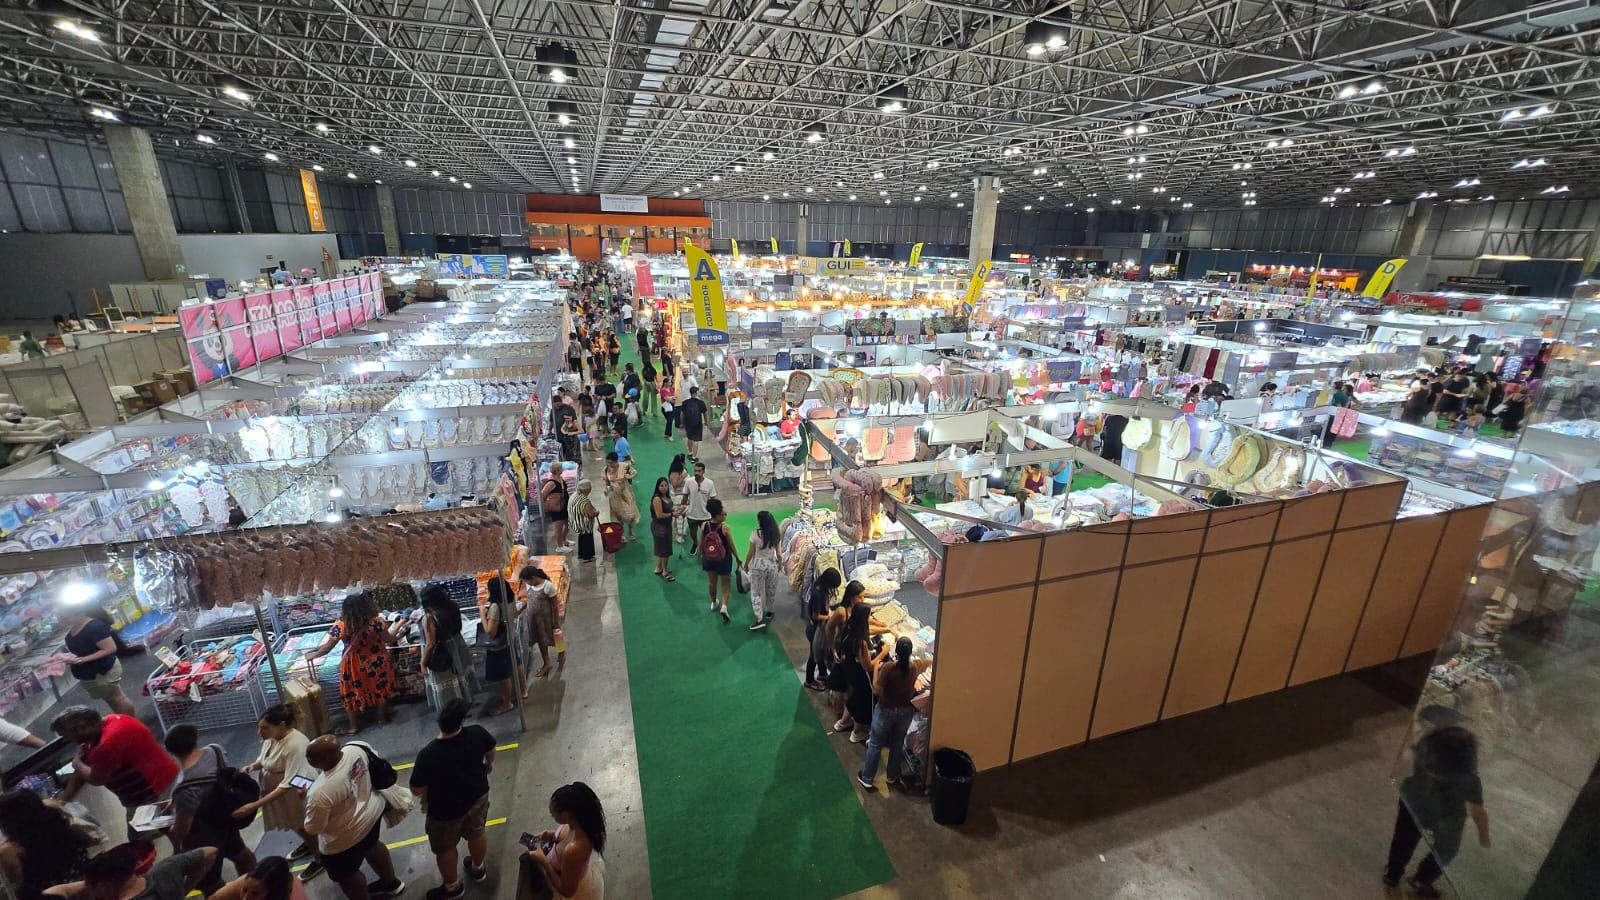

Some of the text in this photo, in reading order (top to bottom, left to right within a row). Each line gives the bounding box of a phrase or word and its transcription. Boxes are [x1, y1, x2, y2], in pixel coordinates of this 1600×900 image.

[694, 259, 716, 281] A
[827, 260, 850, 270] GUI
[979, 264, 987, 279] B
[1383, 262, 1396, 274] D
[702, 285, 713, 327] CORREDOR
[701, 334, 722, 342] mega
